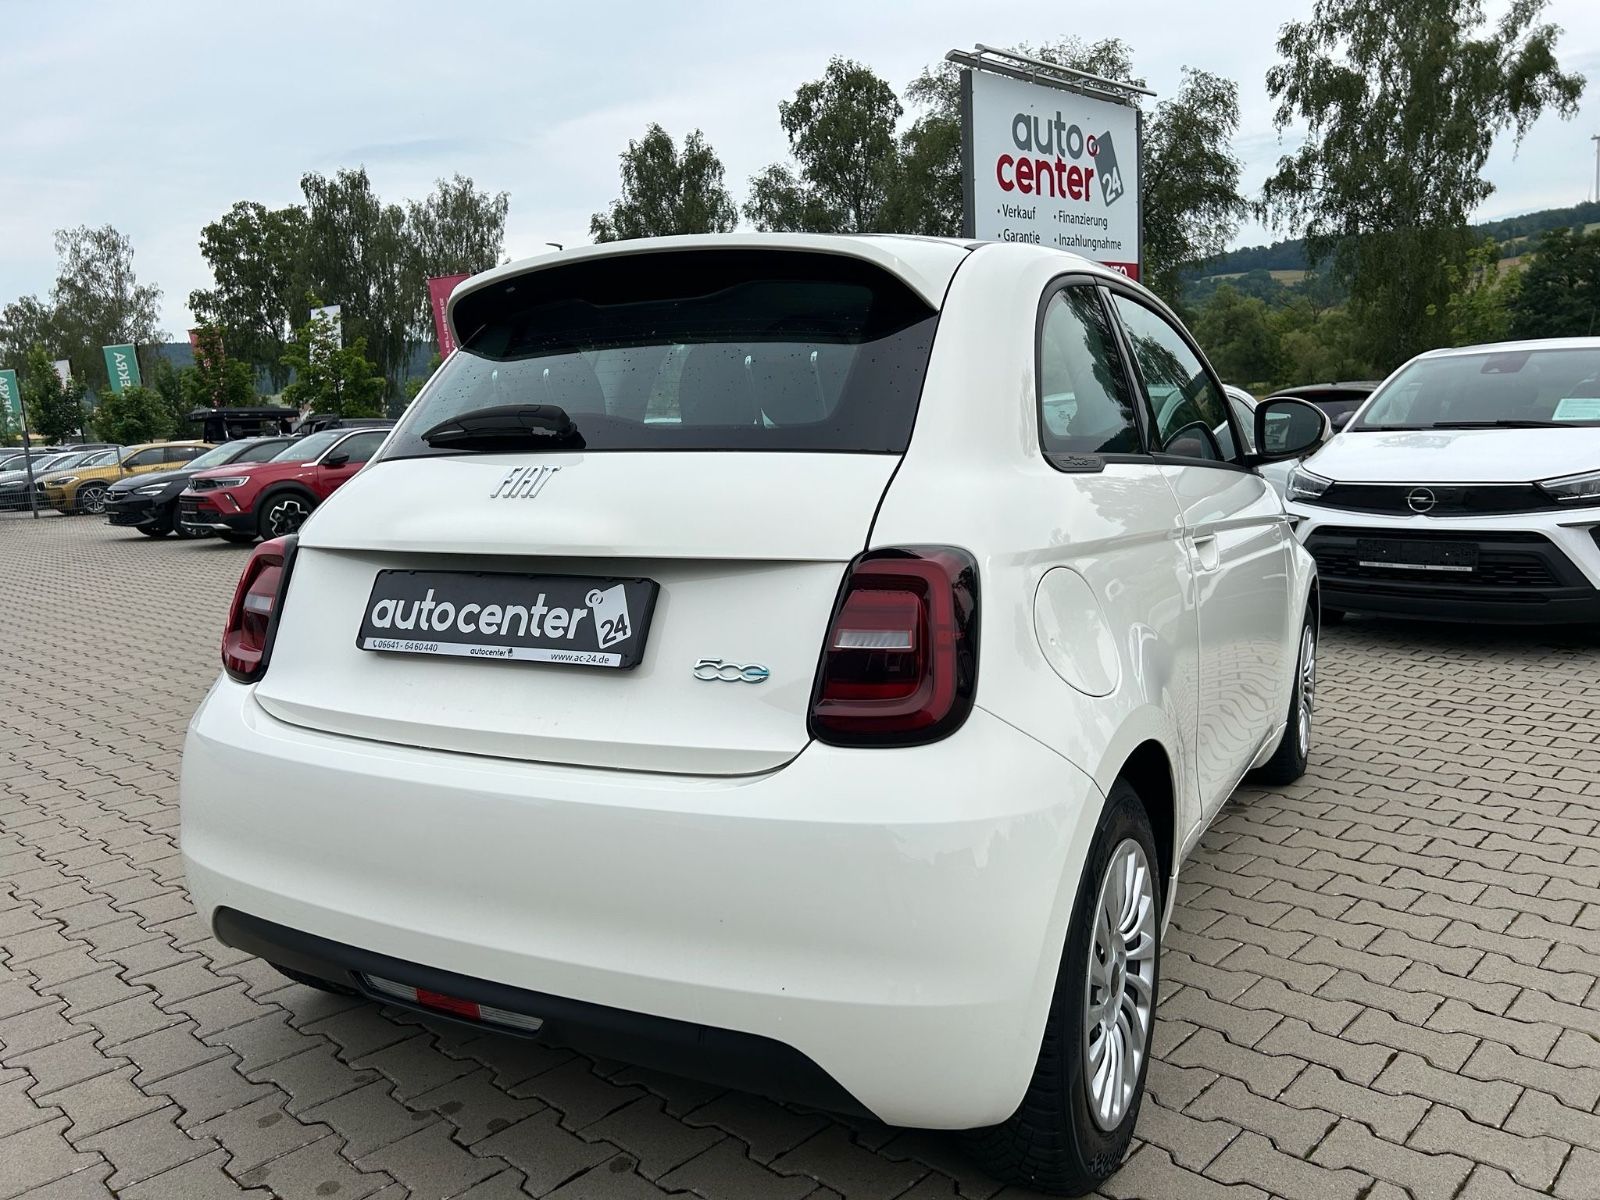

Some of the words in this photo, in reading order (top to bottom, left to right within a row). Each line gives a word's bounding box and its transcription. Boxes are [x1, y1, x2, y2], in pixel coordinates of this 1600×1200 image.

[1012, 110, 1084, 160] auto
[996, 153, 1094, 202] center
[1102, 166, 1122, 201] 24
[1002, 203, 1036, 220] Verkauf
[1058, 210, 1108, 230] Finanzierung
[1003, 228, 1041, 244] Garantie
[1058, 233, 1122, 252] Inzahlungnahme
[489, 464, 561, 499] FIAT
[599, 612, 629, 645] 24
[469, 646, 507, 658] autocenter
[550, 652, 610, 665] www.ac-24.de
